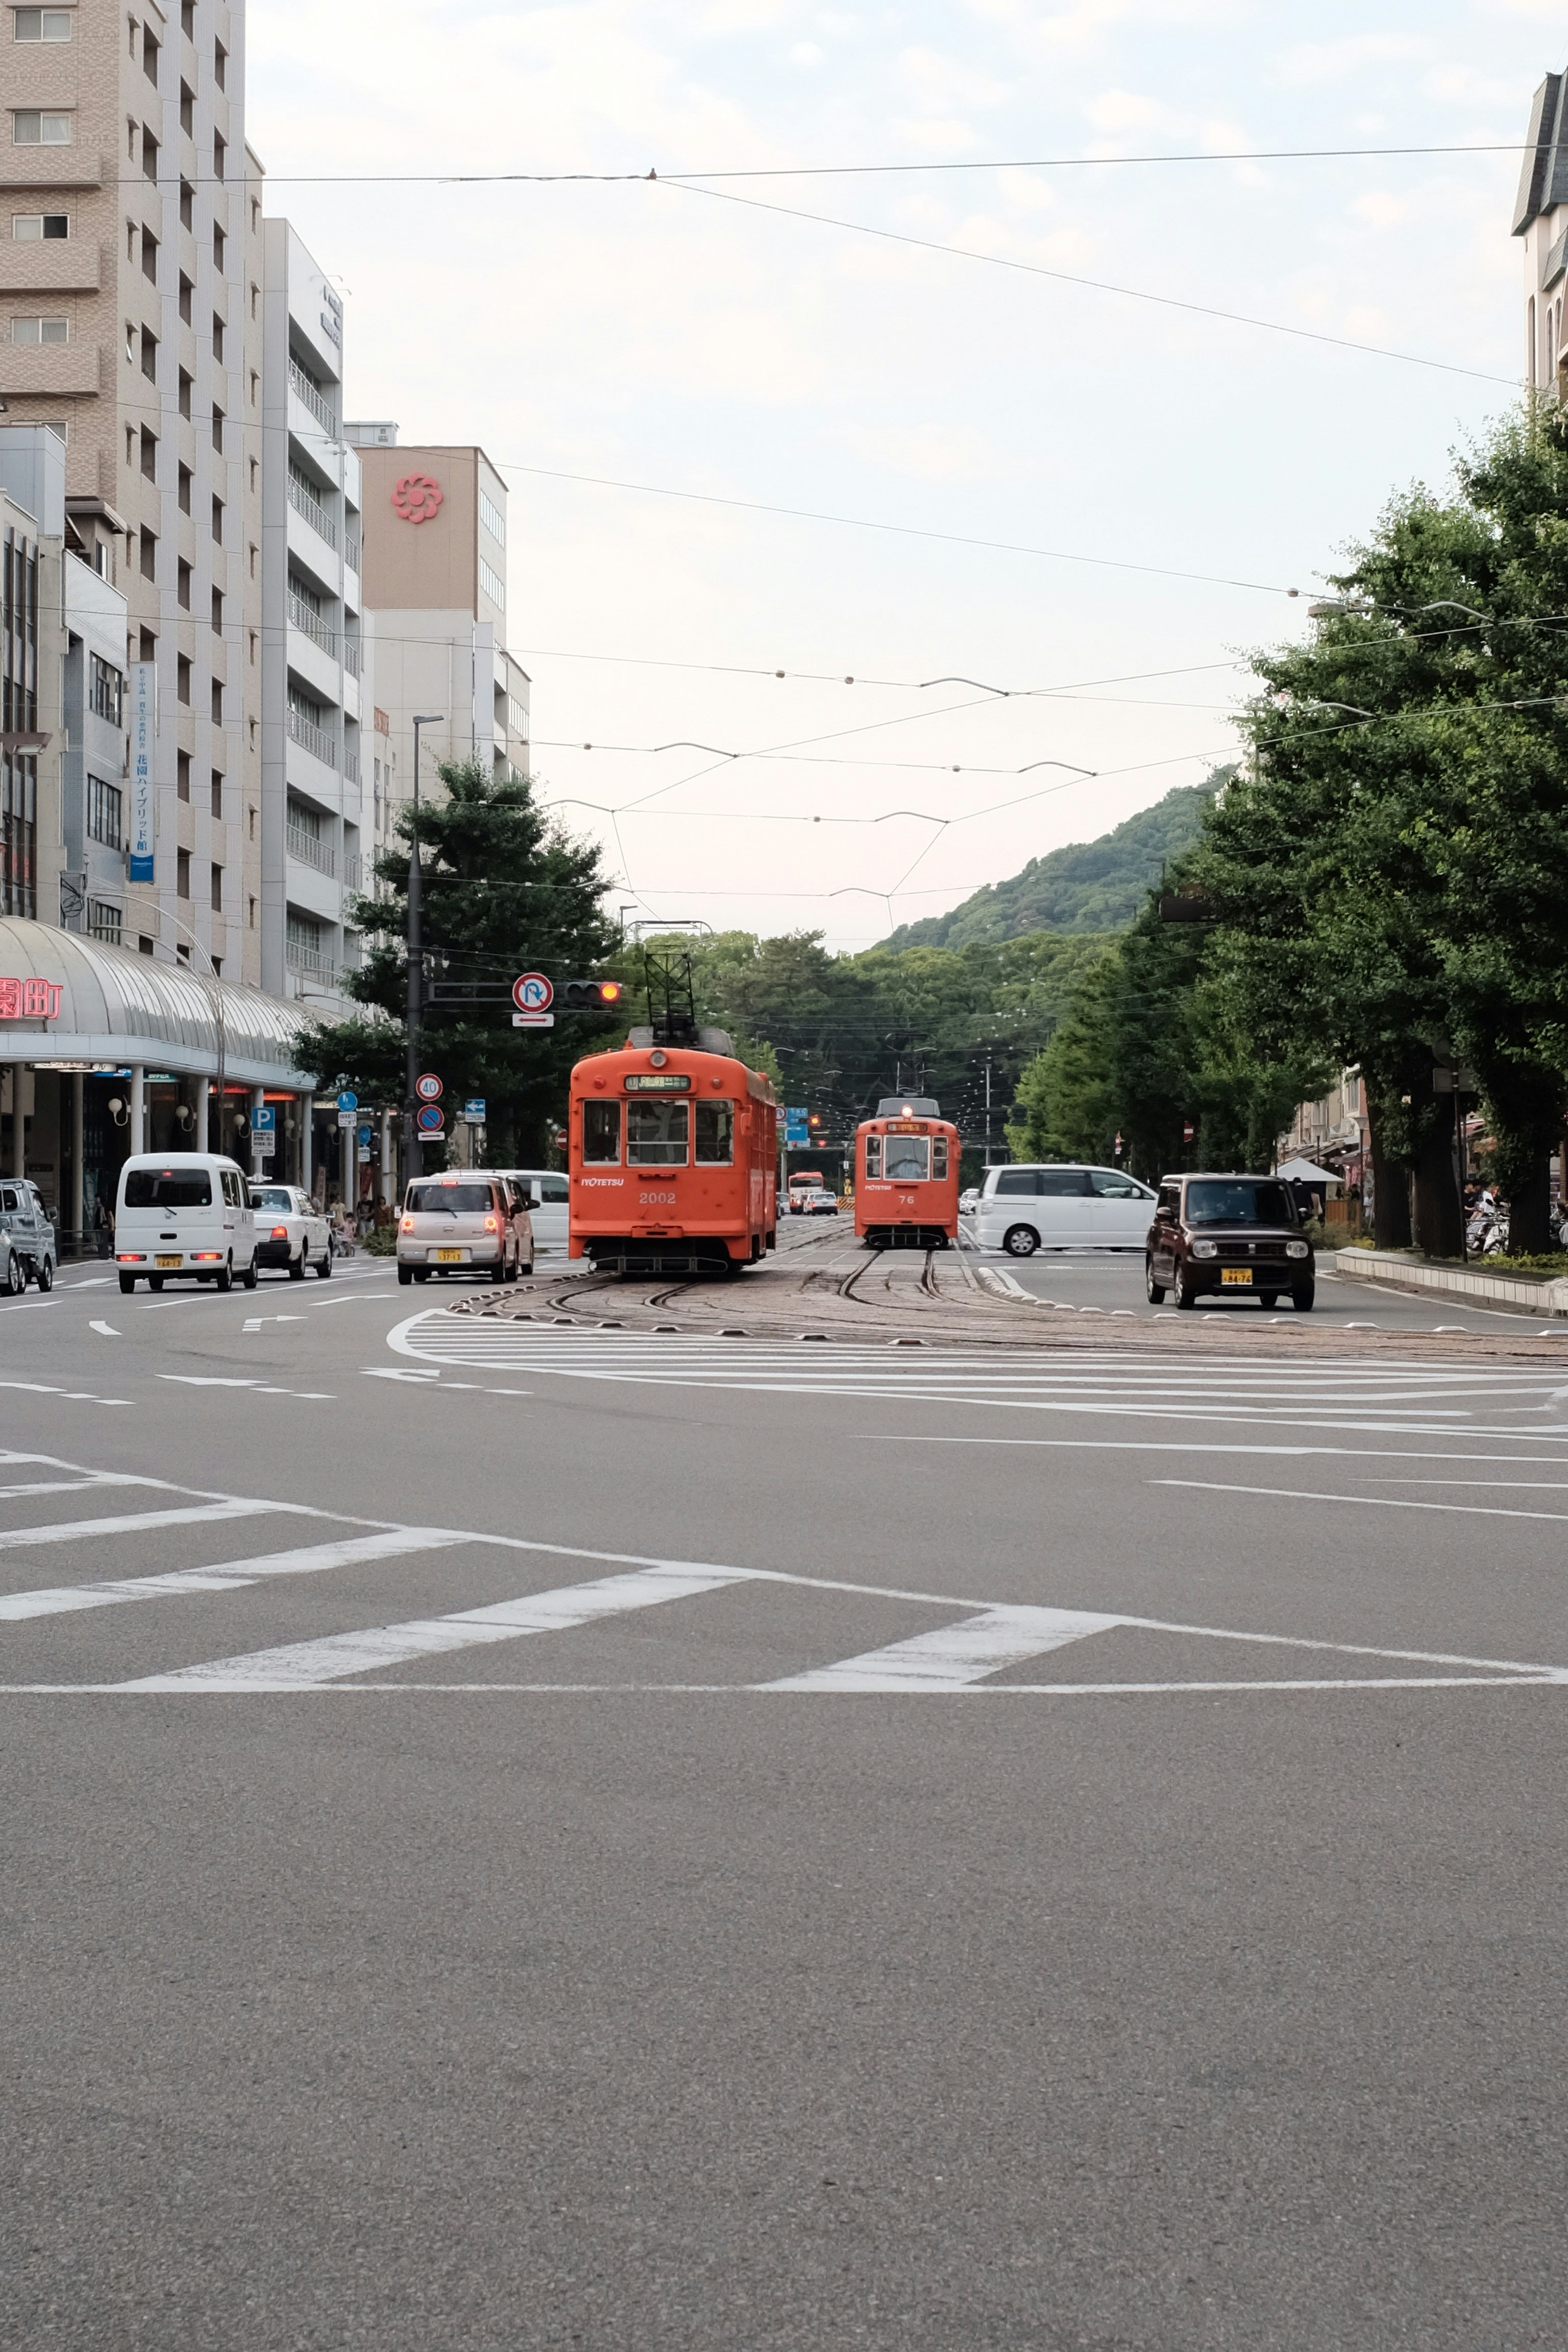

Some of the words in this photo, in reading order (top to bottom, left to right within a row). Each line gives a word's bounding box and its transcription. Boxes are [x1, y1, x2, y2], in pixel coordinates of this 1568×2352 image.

[137, 754, 148, 851] 花園ハイブリッド館
[423, 1081, 436, 1093] 40
[257, 1109, 271, 1128] P
[581, 1178, 624, 1187] IYOTETSU
[639, 1192, 676, 1204] 2002
[899, 1195, 914, 1205] 76
